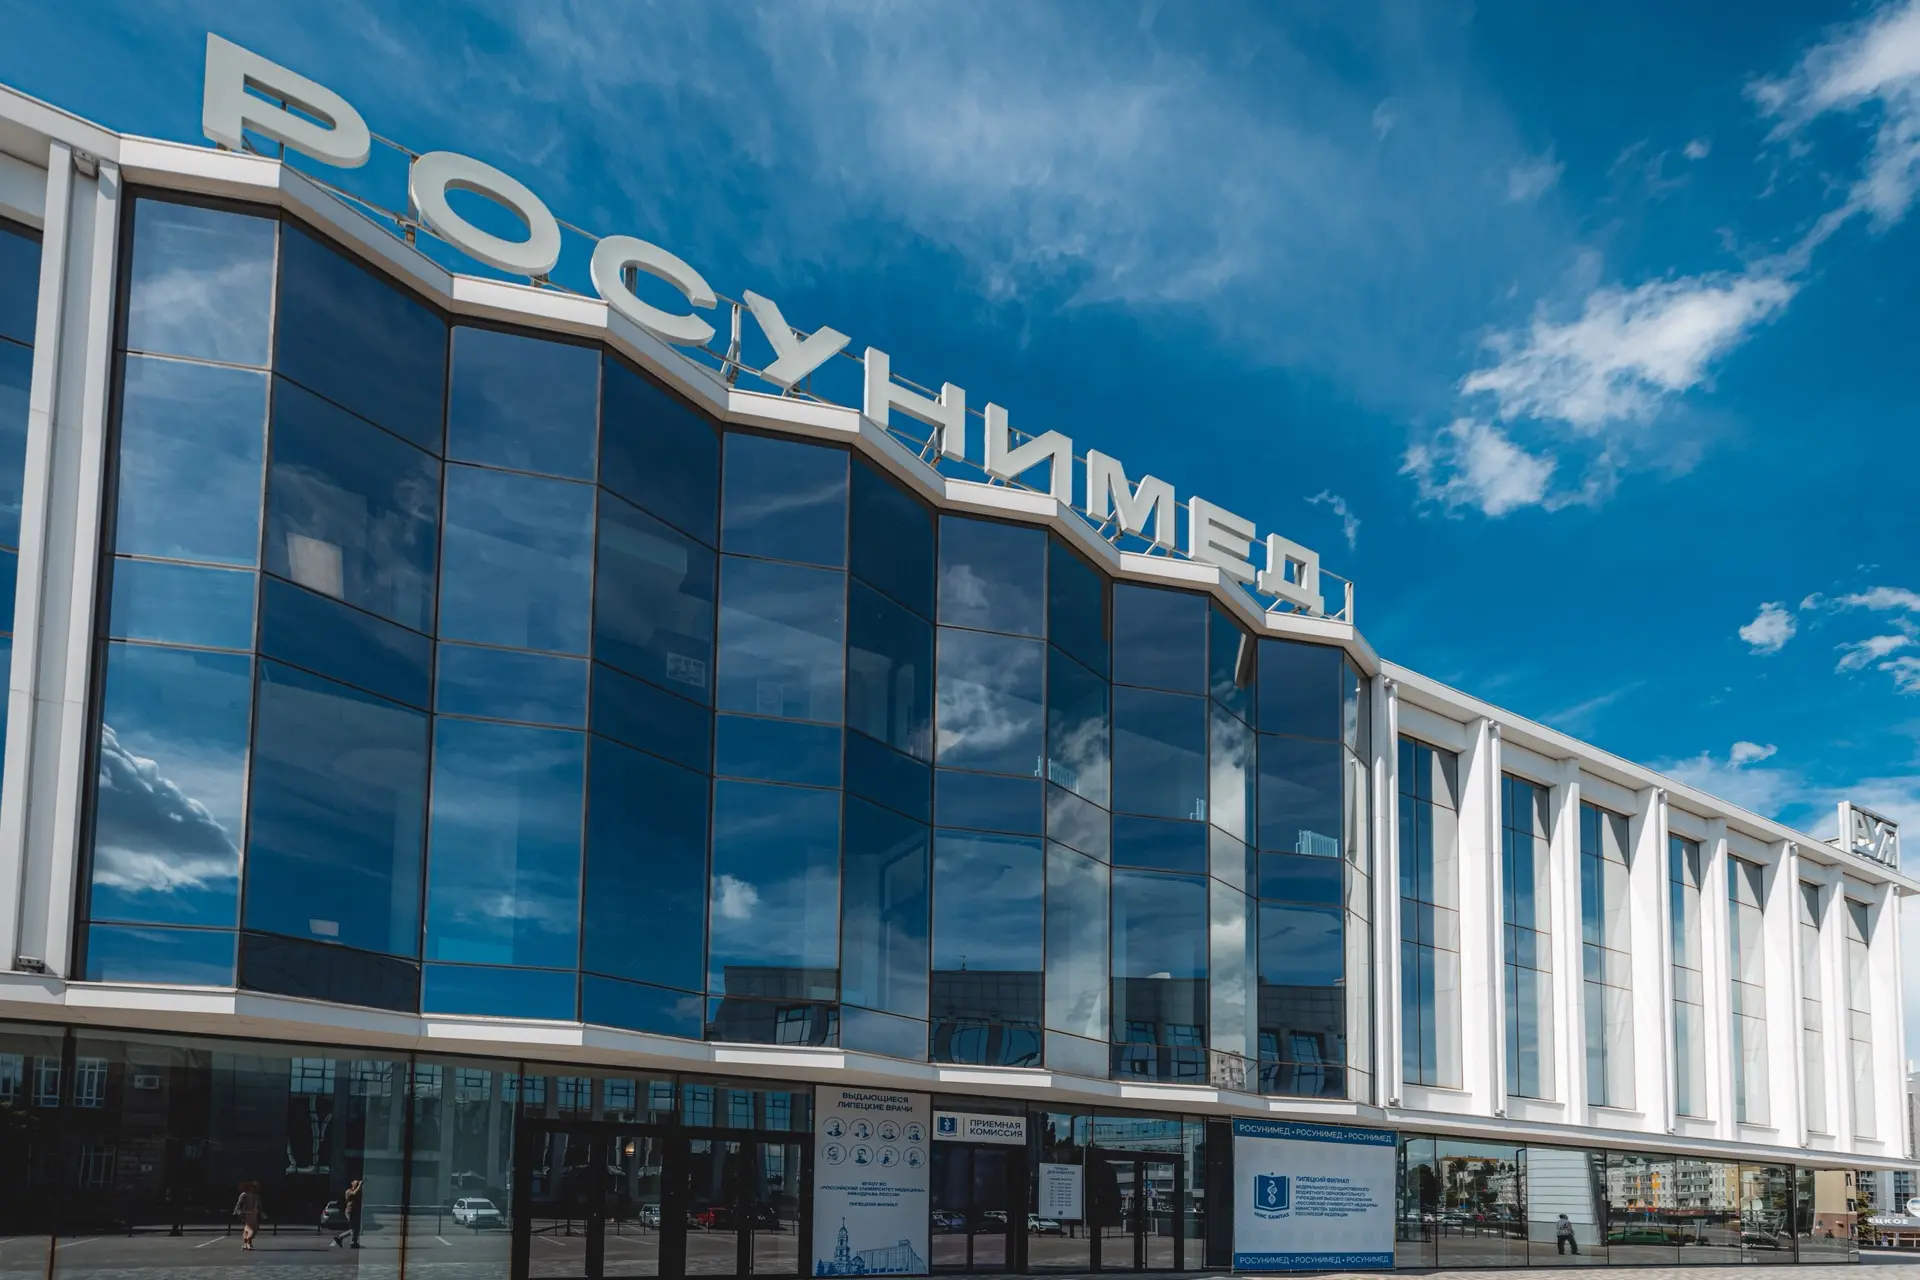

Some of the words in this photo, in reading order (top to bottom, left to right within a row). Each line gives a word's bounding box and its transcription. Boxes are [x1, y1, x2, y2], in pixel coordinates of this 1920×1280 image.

[202, 32, 1324, 618] РОСУНИМЕД
[842, 1092, 909, 1103] ВЫДАЮЩИЕСЯ
[837, 1101, 884, 1111] ЛИПЕЦКИЕ
[886, 1104, 913, 1112] ВРАЧИ
[970, 1119, 1021, 1129] ПРИЕМНАЯ
[970, 1127, 1023, 1138] КОМИССИЯ
[1239, 1124, 1291, 1135] РОСУНИМЕД
[1296, 1129, 1344, 1140] РОСУНИМЕД
[1348, 1133, 1392, 1143] РОСУНИМЕД
[1239, 1256, 1290, 1265] РОСУНИМЕД
[1295, 1256, 1341, 1264] РОСУНИМЕД
[1346, 1255, 1389, 1264] РОСУНИМЕД
